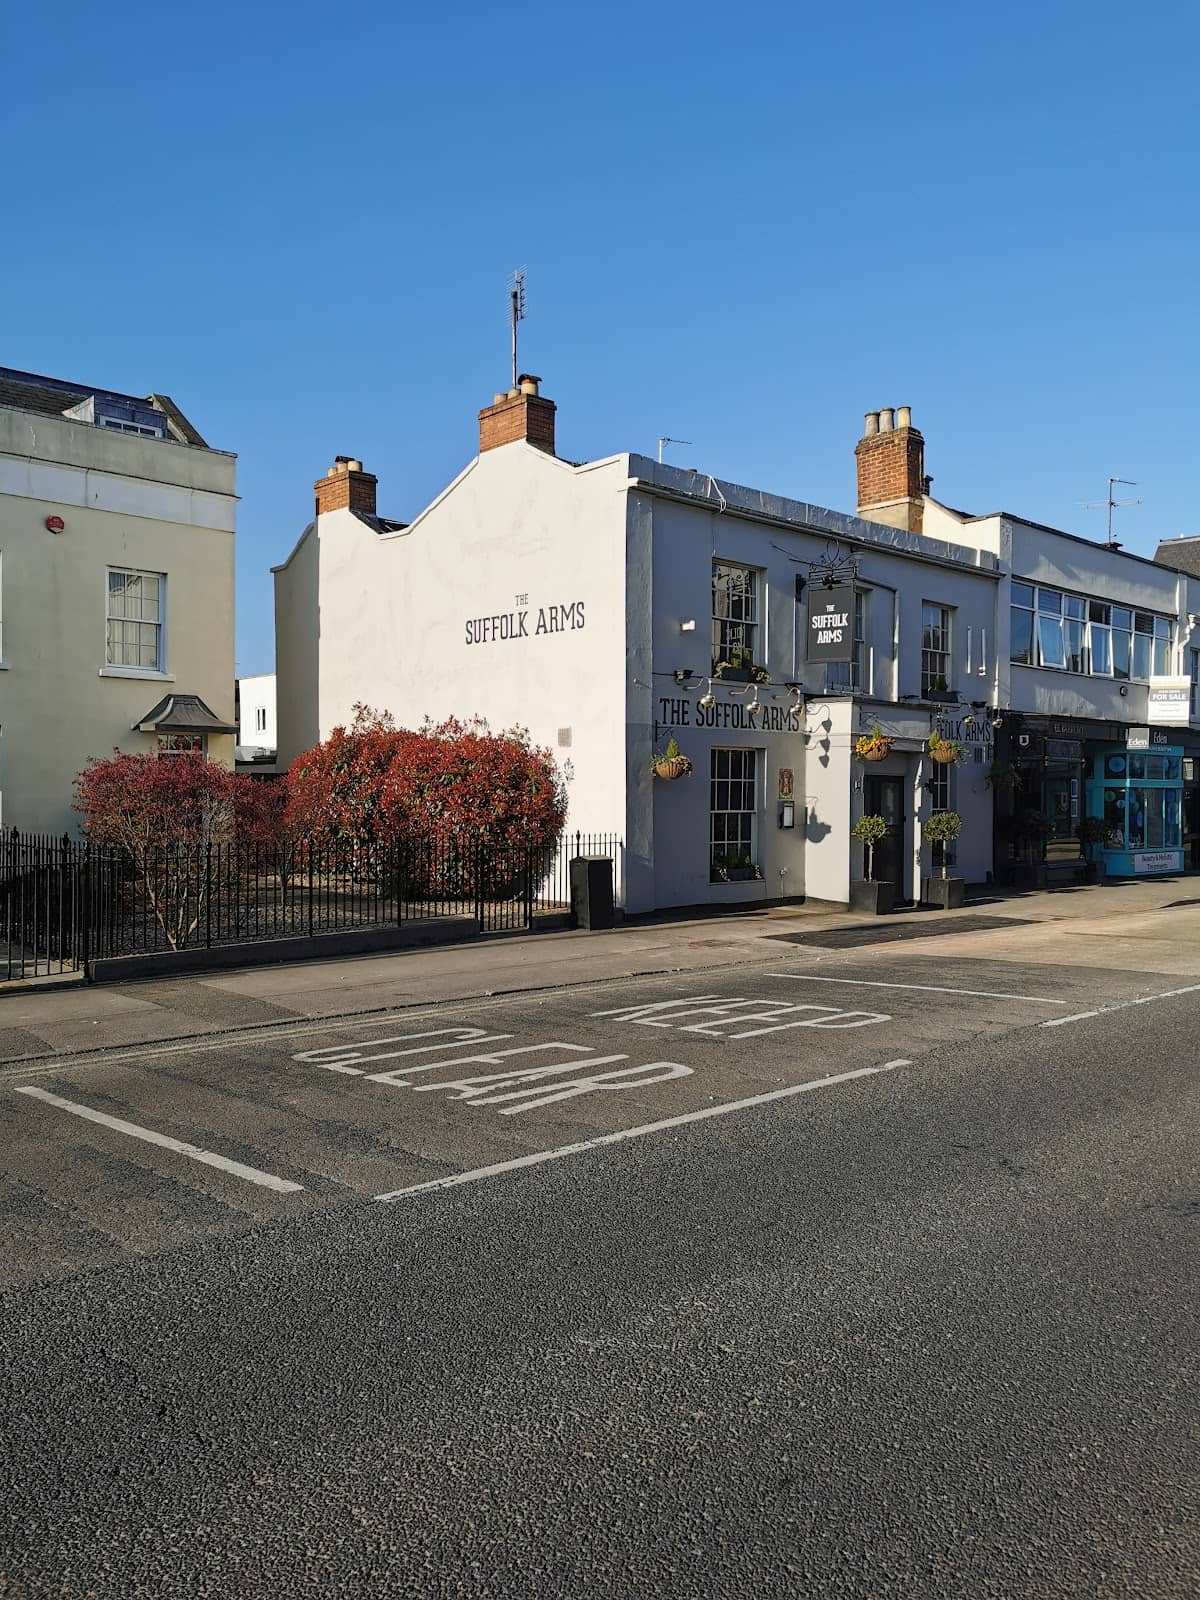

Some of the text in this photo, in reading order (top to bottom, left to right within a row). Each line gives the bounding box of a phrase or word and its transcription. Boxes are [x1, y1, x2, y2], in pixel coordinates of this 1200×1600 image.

[515, 593, 529, 606] THE
[826, 604, 836, 612] THE
[465, 601, 585, 645] SUFFOLK ARMS
[811, 613, 849, 629] SUFFOLK
[816, 629, 843, 644] ARMS
[1152, 693, 1187, 701] FOR SALE
[659, 697, 800, 732] THE SUFFOLK ARMS
[965, 719, 991, 742] ARMS
[1153, 730, 1168, 744] Eden
[1128, 737, 1147, 746] Eden
[588, 994, 892, 1039] KEEP
[290, 1027, 695, 1116] CLEAR
